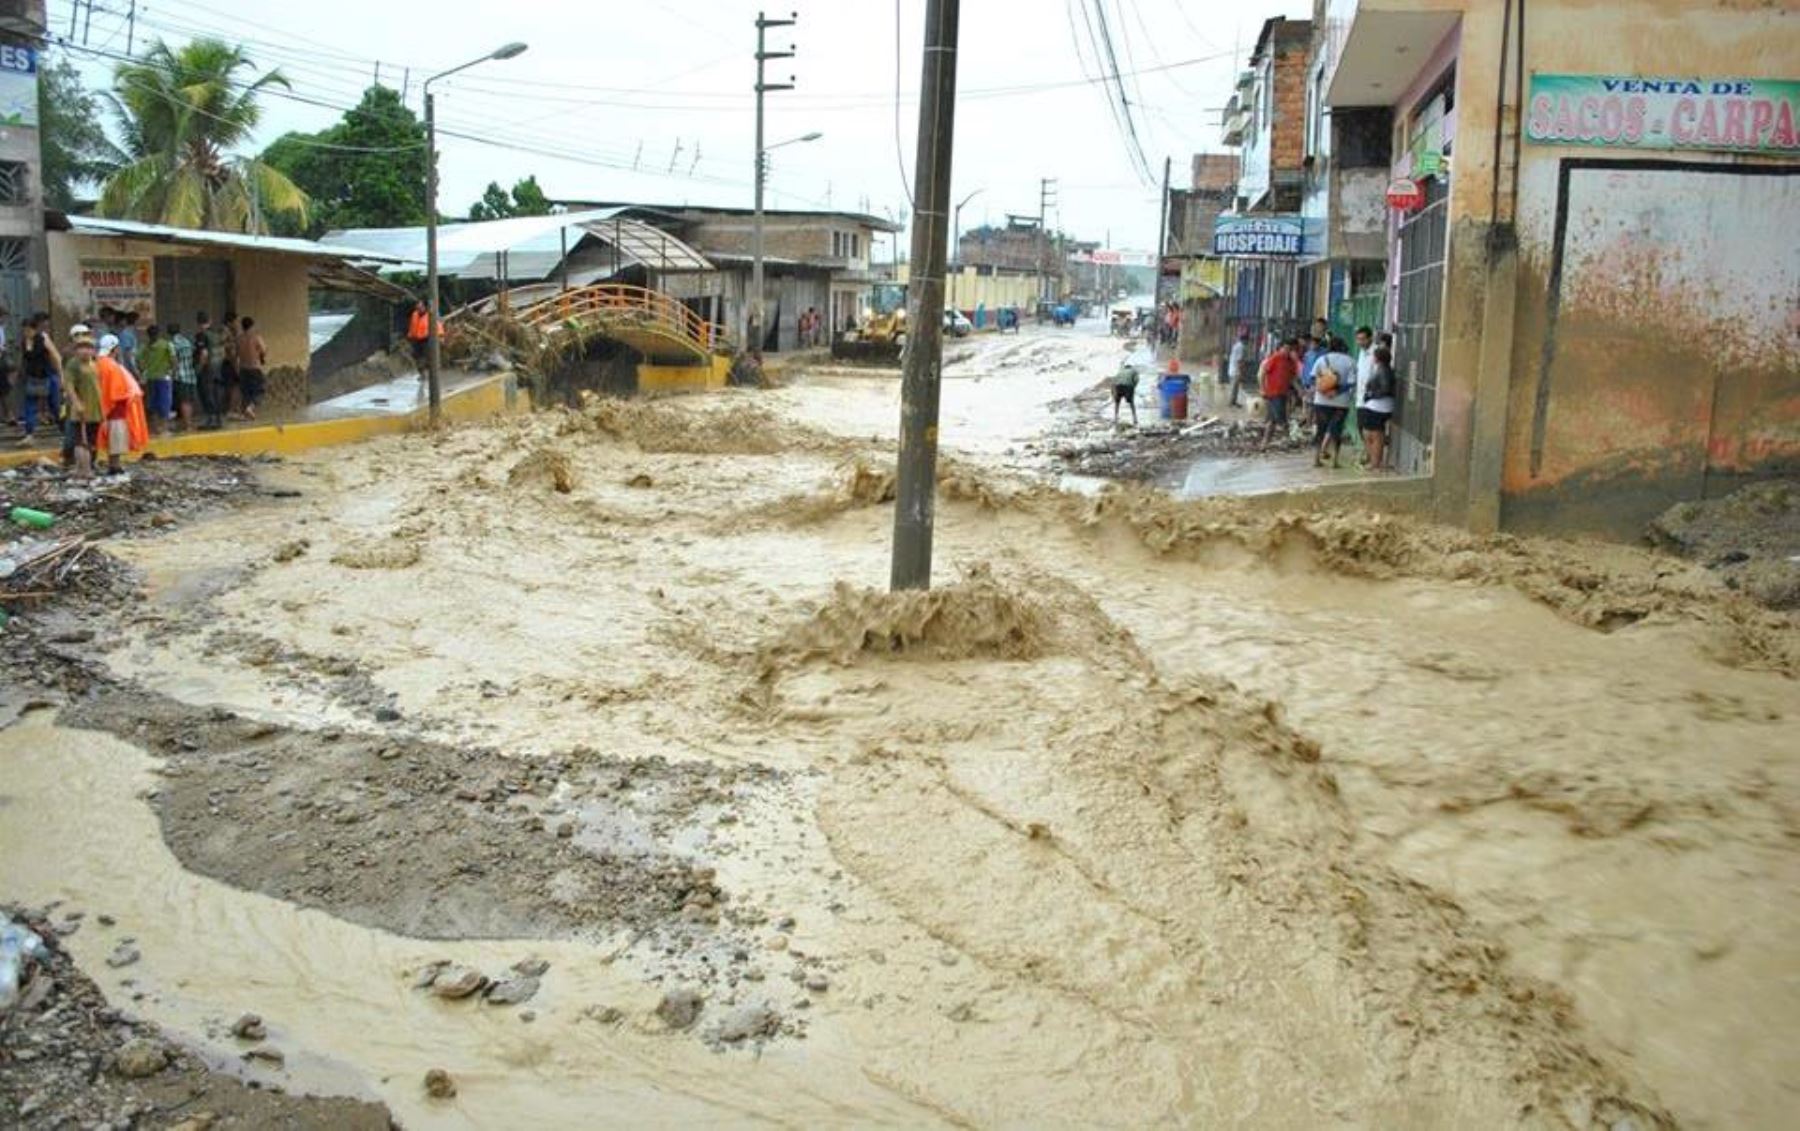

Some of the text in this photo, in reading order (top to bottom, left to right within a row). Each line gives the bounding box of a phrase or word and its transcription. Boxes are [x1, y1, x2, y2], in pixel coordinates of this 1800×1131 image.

[1602, 79, 1751, 95] VENTA DE
[1530, 95, 1646, 140] SACOS
[1670, 98, 1800, 147] CARPA
[1217, 233, 1299, 252] HOSPEDAJE
